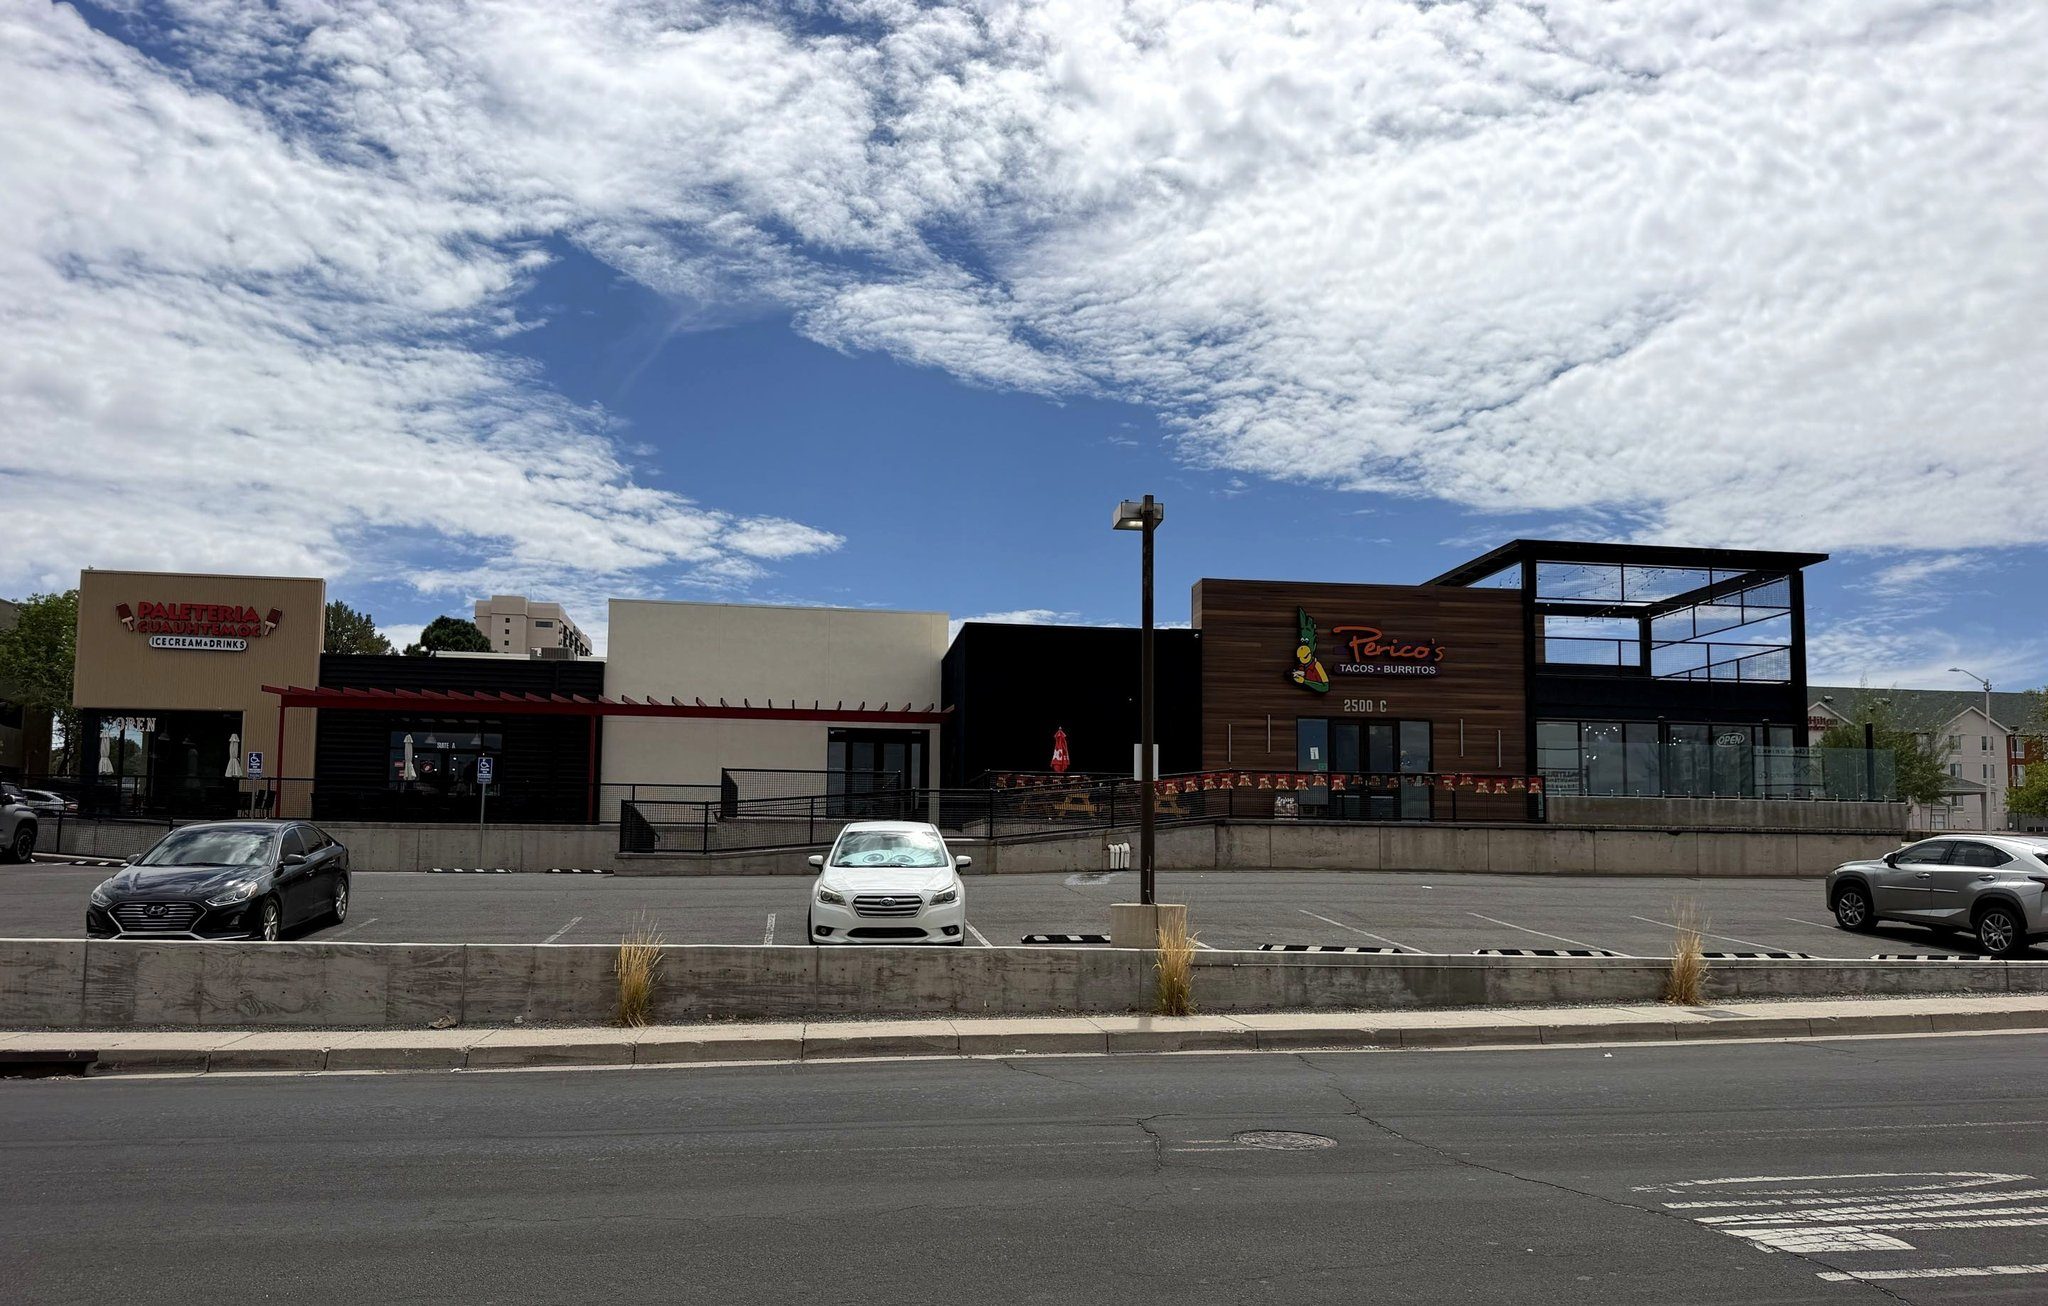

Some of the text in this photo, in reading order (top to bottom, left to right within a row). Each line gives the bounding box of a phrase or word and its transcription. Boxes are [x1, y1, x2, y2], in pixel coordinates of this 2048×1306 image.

[138, 601, 261, 623] PALETERIA
[138, 620, 261, 637] CUAUHTEMOC
[151, 637, 166, 646] ICE
[1333, 626, 1445, 662] Perico's
[1340, 664, 1436, 674] TACOS BURRITOS
[1344, 699, 1387, 713] 2500 C
[115, 717, 156, 732] OPEN
[1808, 716, 1838, 725] Hilton
[1718, 735, 1742, 744] OPEN
